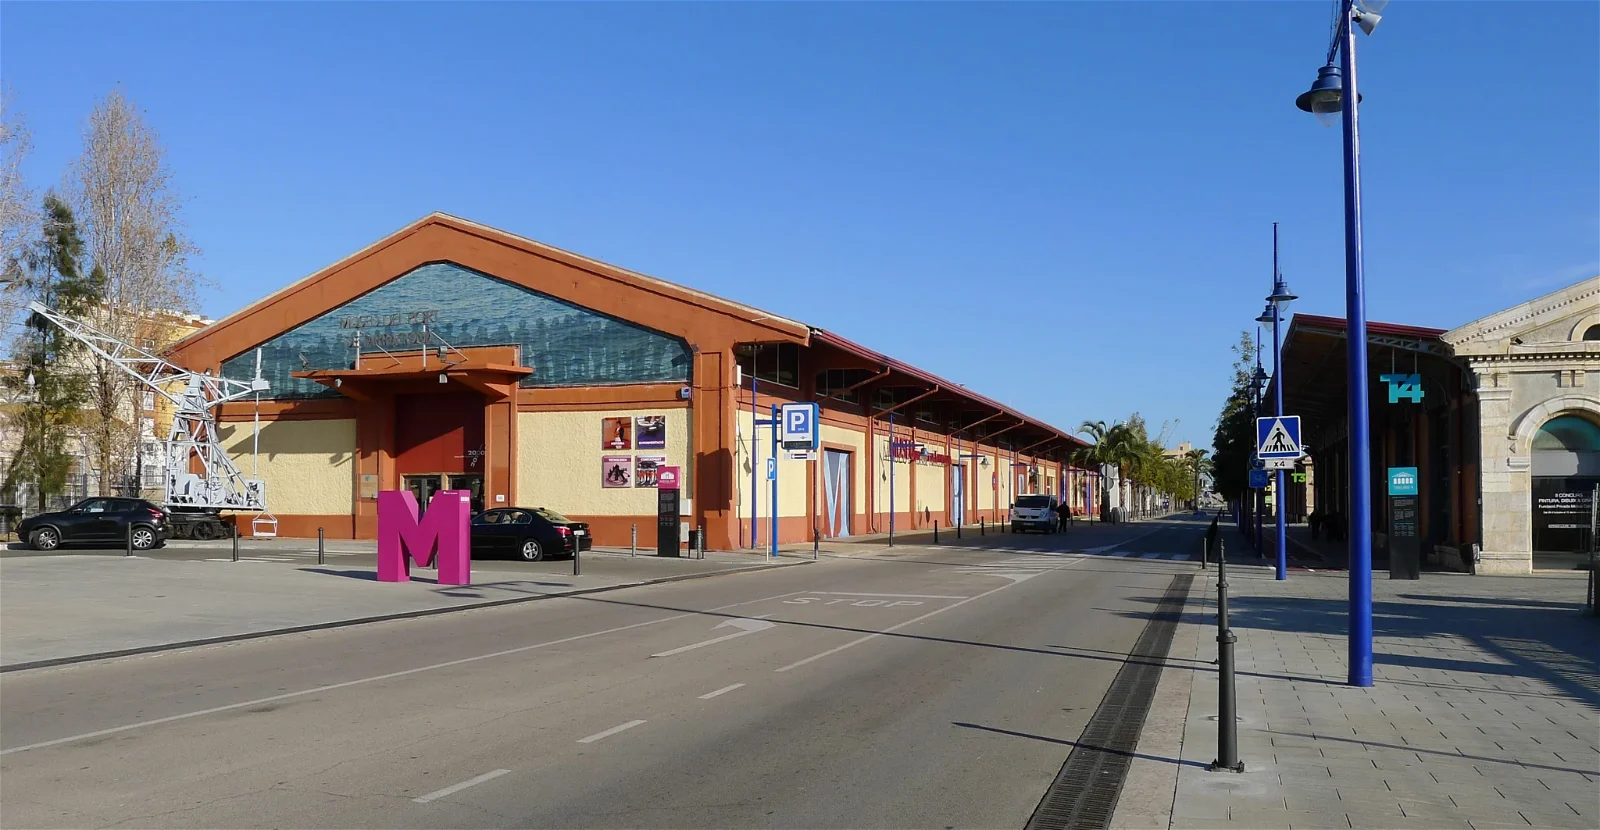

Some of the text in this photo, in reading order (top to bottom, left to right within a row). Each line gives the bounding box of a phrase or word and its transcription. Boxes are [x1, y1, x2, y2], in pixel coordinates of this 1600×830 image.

[1380, 374, 1425, 403] T4
[791, 412, 805, 431] P
[768, 460, 775, 478] P
[1291, 472, 1306, 483] T3
[377, 489, 471, 586] M
[783, 597, 924, 608] STOP
